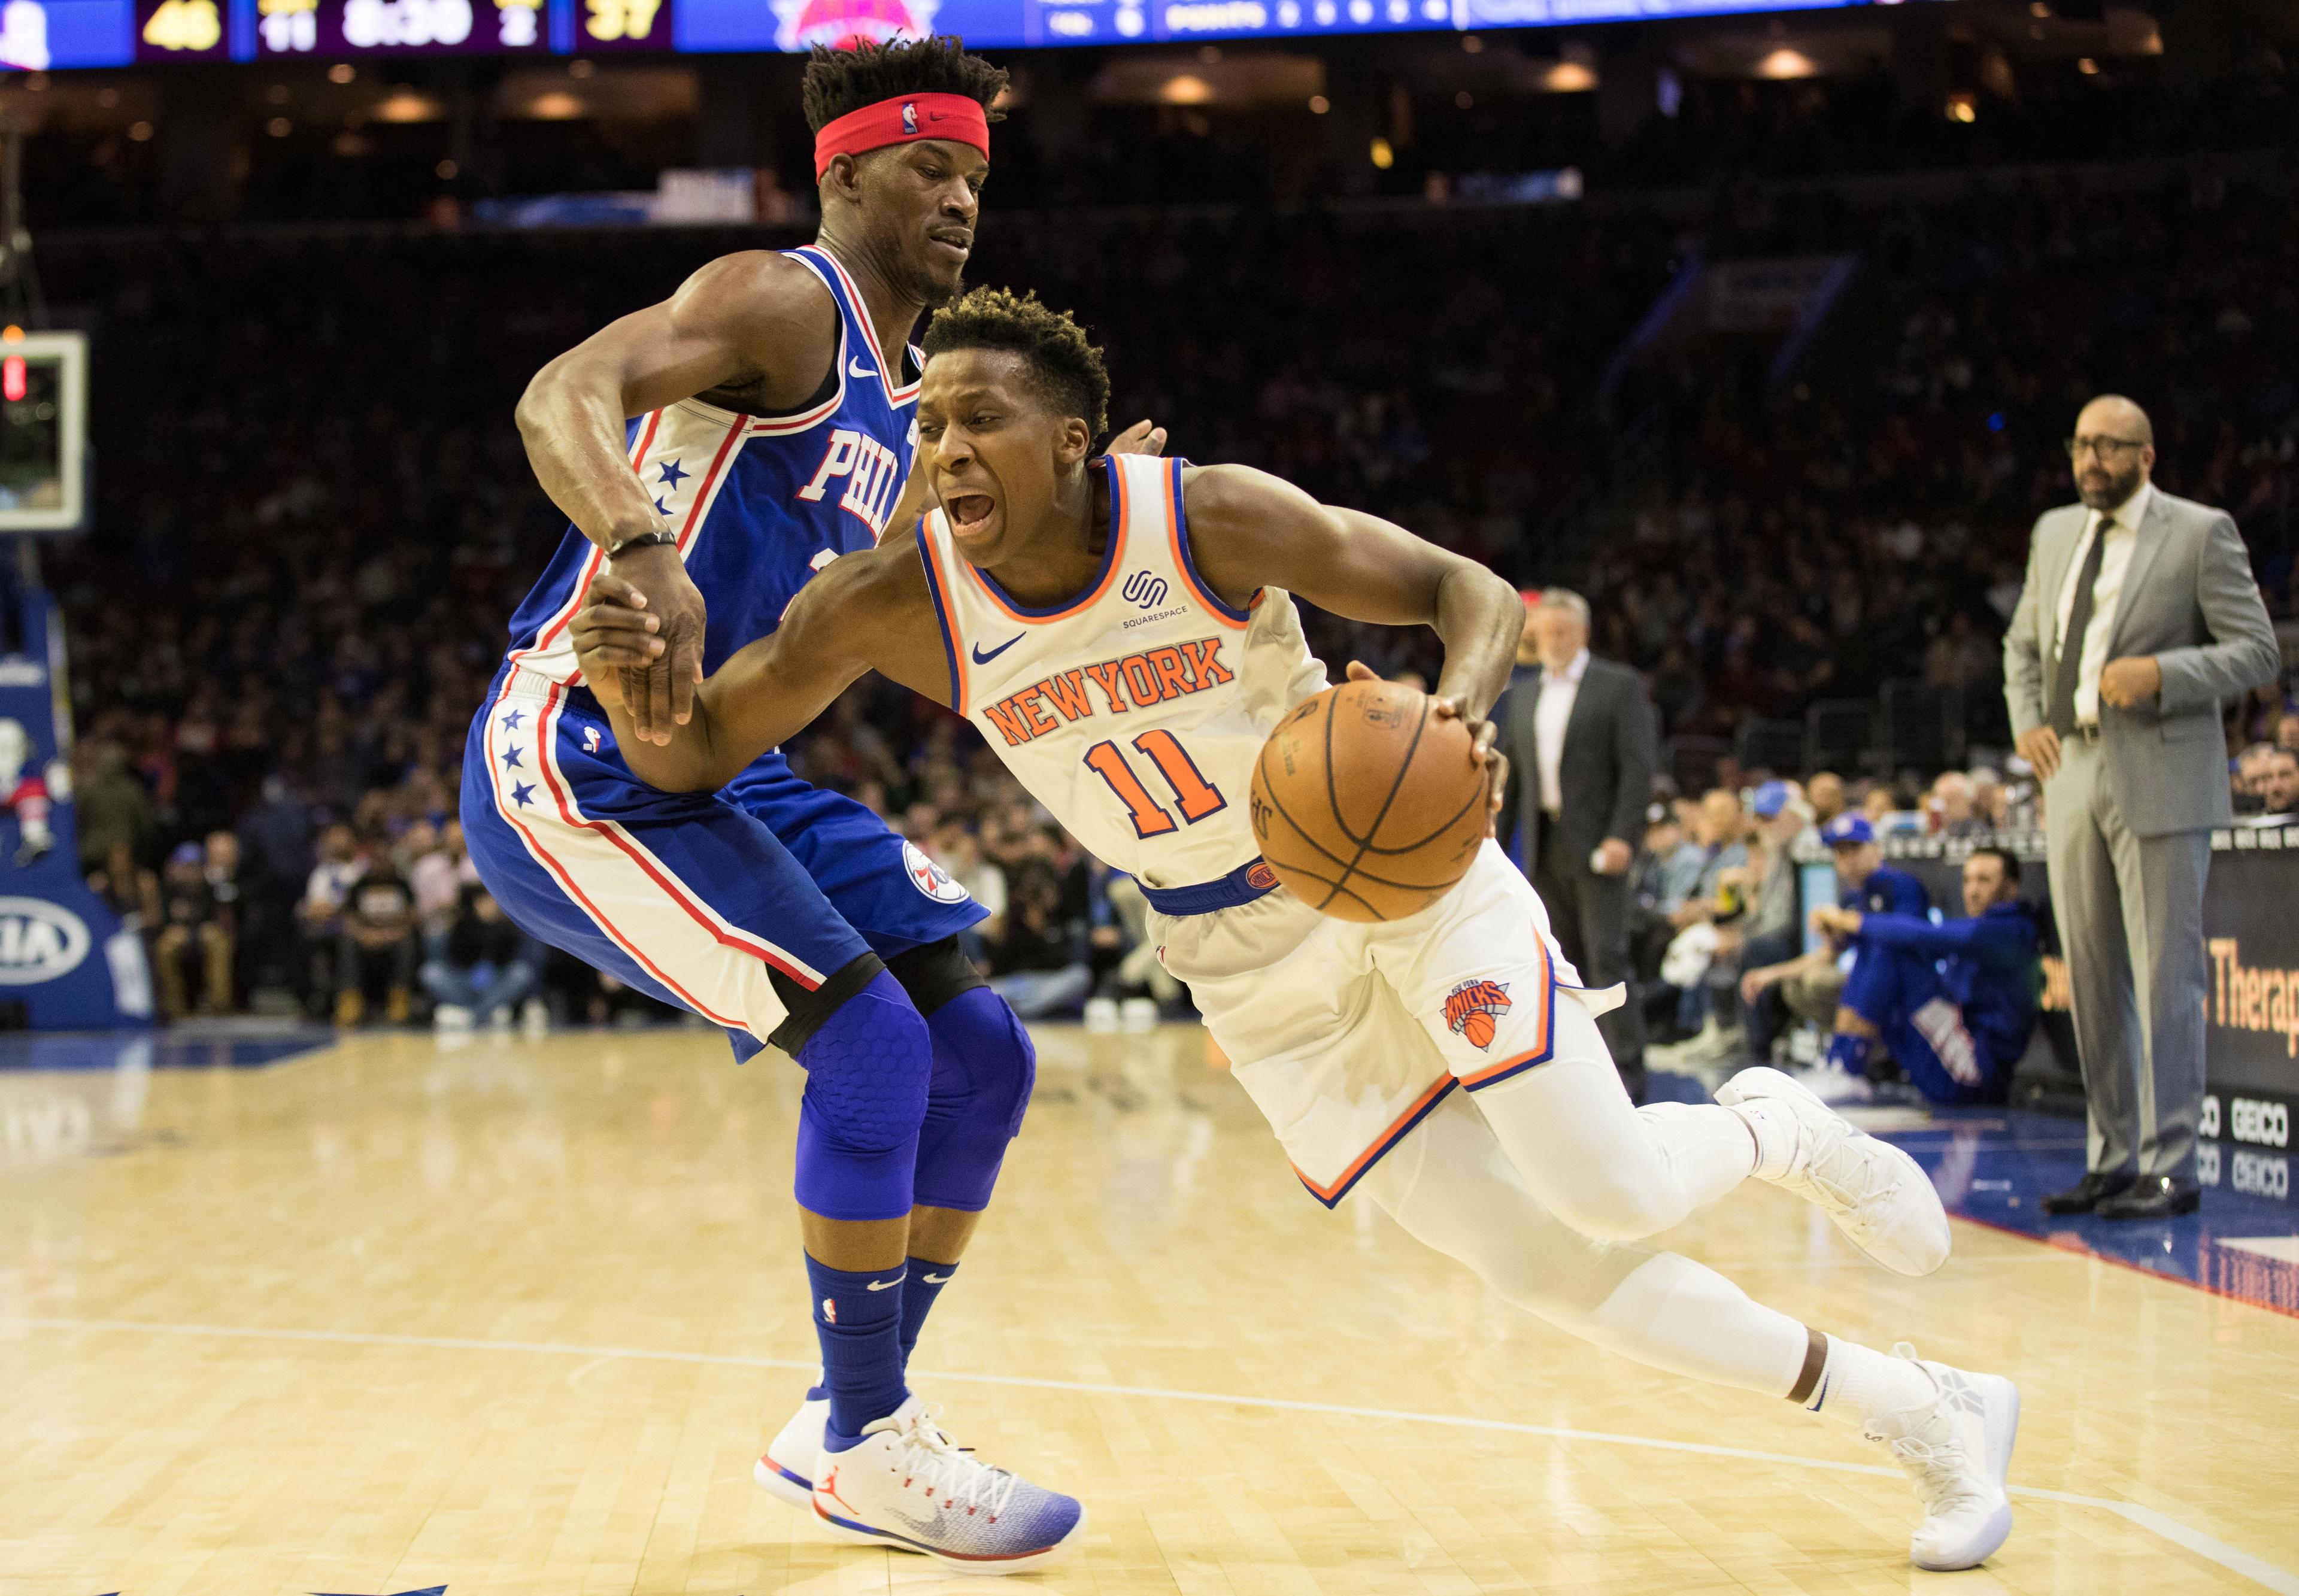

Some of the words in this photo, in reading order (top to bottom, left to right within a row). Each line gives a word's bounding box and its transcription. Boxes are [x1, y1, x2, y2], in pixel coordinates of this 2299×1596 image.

[1123, 605, 1187, 629] SQUARESPACE
[1082, 729, 1228, 839] 11
[0, 917, 61, 966] IA
[1445, 981, 1512, 1030] KNICKS
[2231, 1097, 2288, 1148] GEICO
